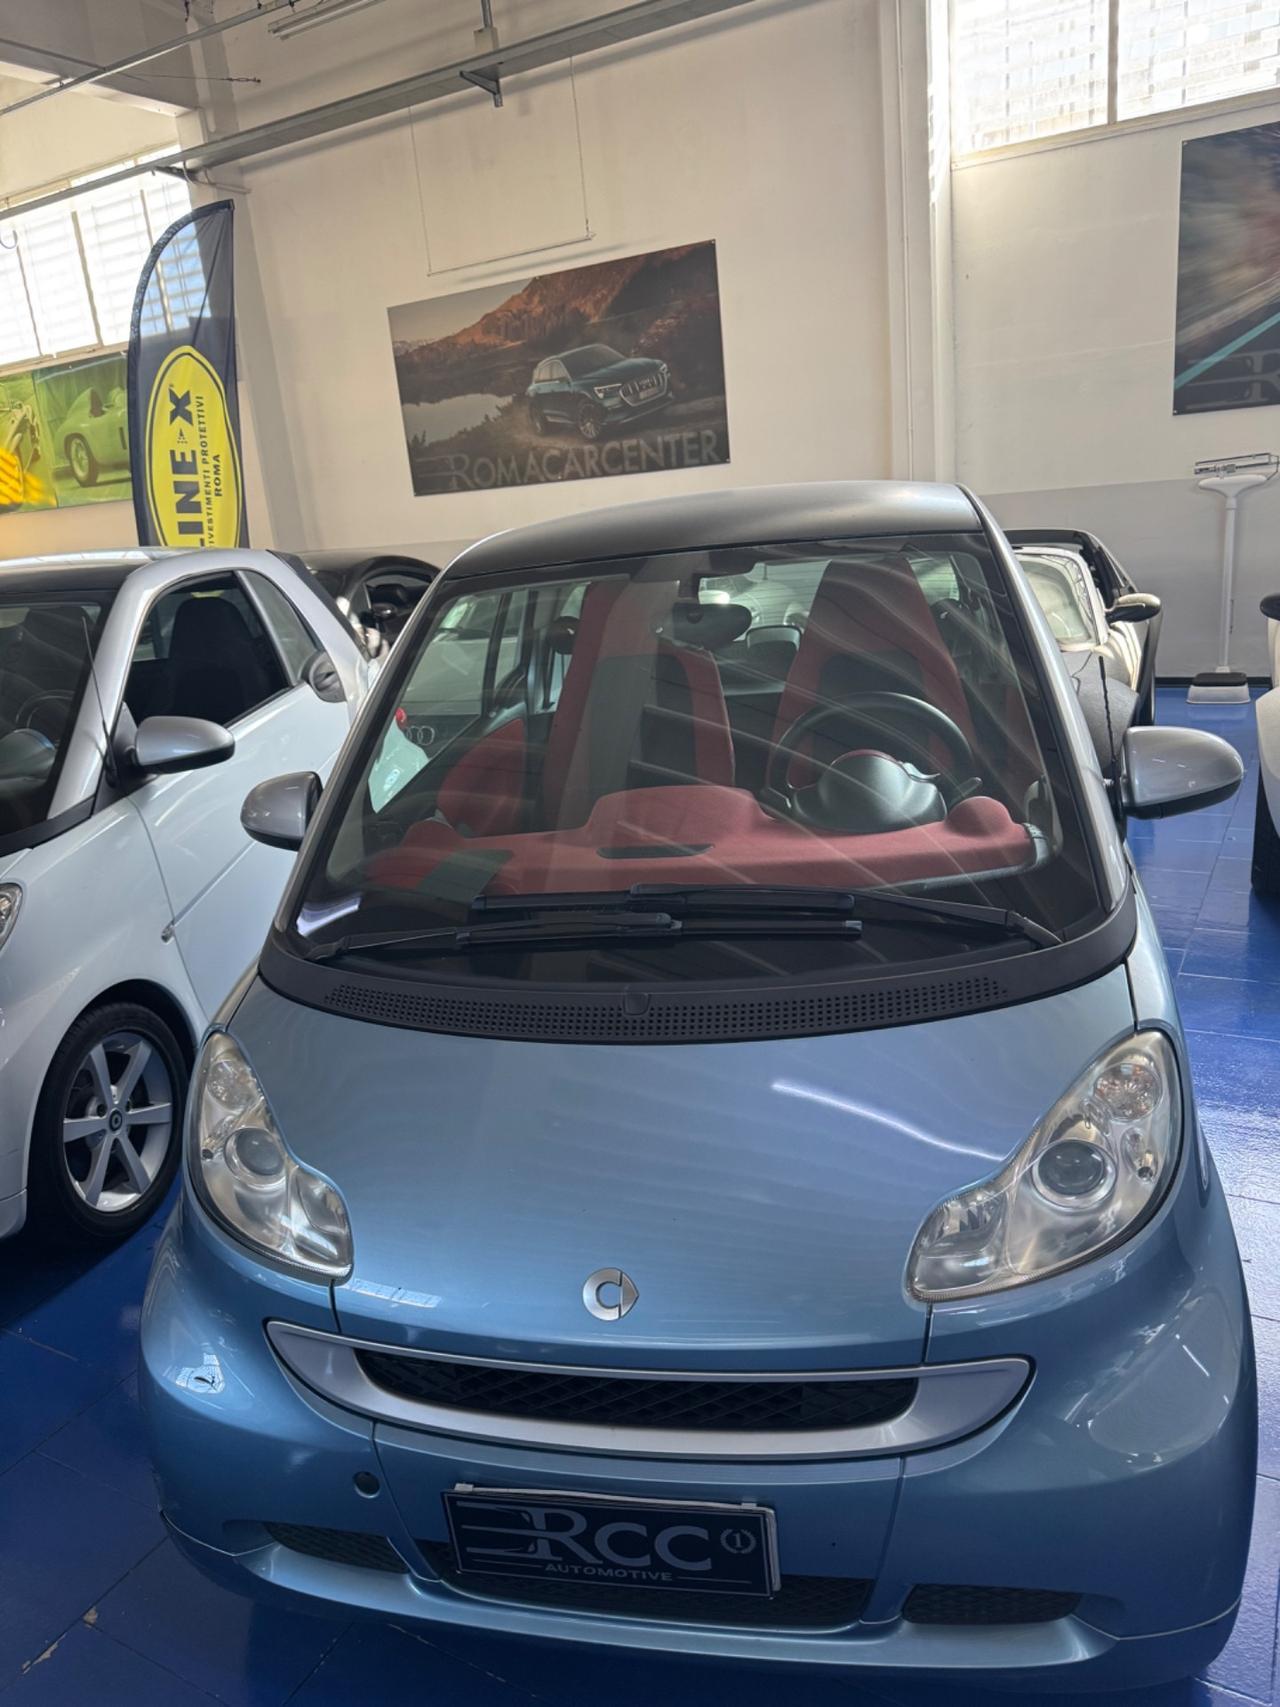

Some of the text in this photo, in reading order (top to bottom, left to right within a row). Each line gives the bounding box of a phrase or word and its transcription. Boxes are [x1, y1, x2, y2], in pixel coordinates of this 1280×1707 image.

[196, 396, 215, 544] IVESTIMENTI PROTETTIVI
[212, 454, 223, 497] ROMA
[521, 1507, 712, 1572] RCC
[545, 1562, 673, 1581] AUTOMOTIVE
